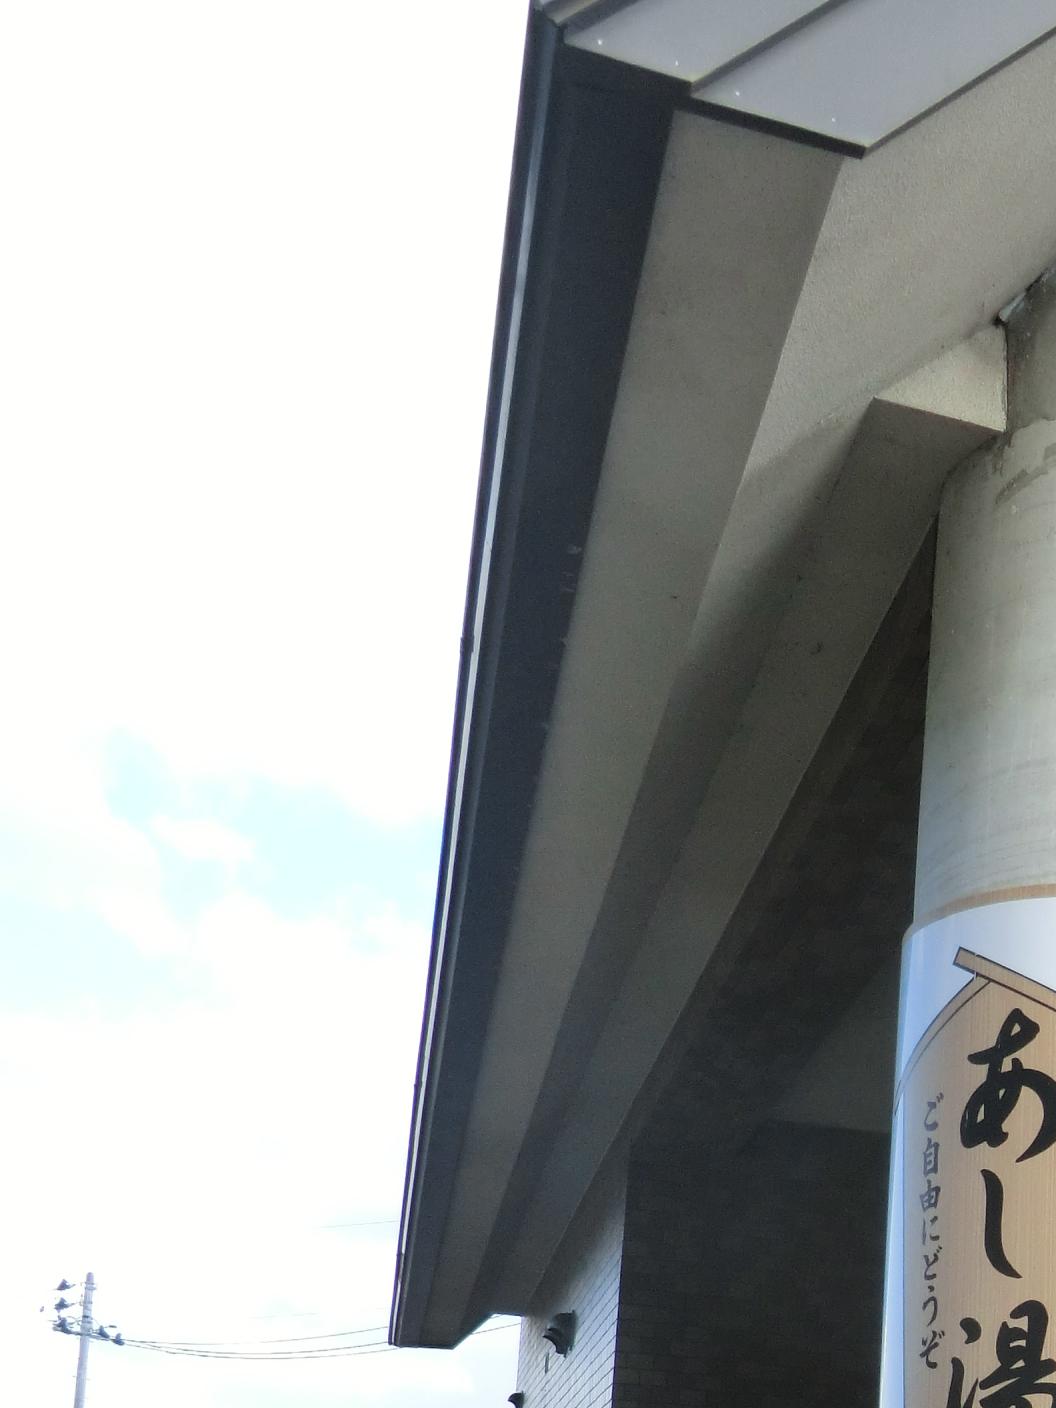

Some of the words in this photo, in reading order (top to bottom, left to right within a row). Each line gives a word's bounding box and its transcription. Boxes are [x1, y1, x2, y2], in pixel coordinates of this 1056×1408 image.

[919, 1092, 945, 1369] ご自由にどうぞ
